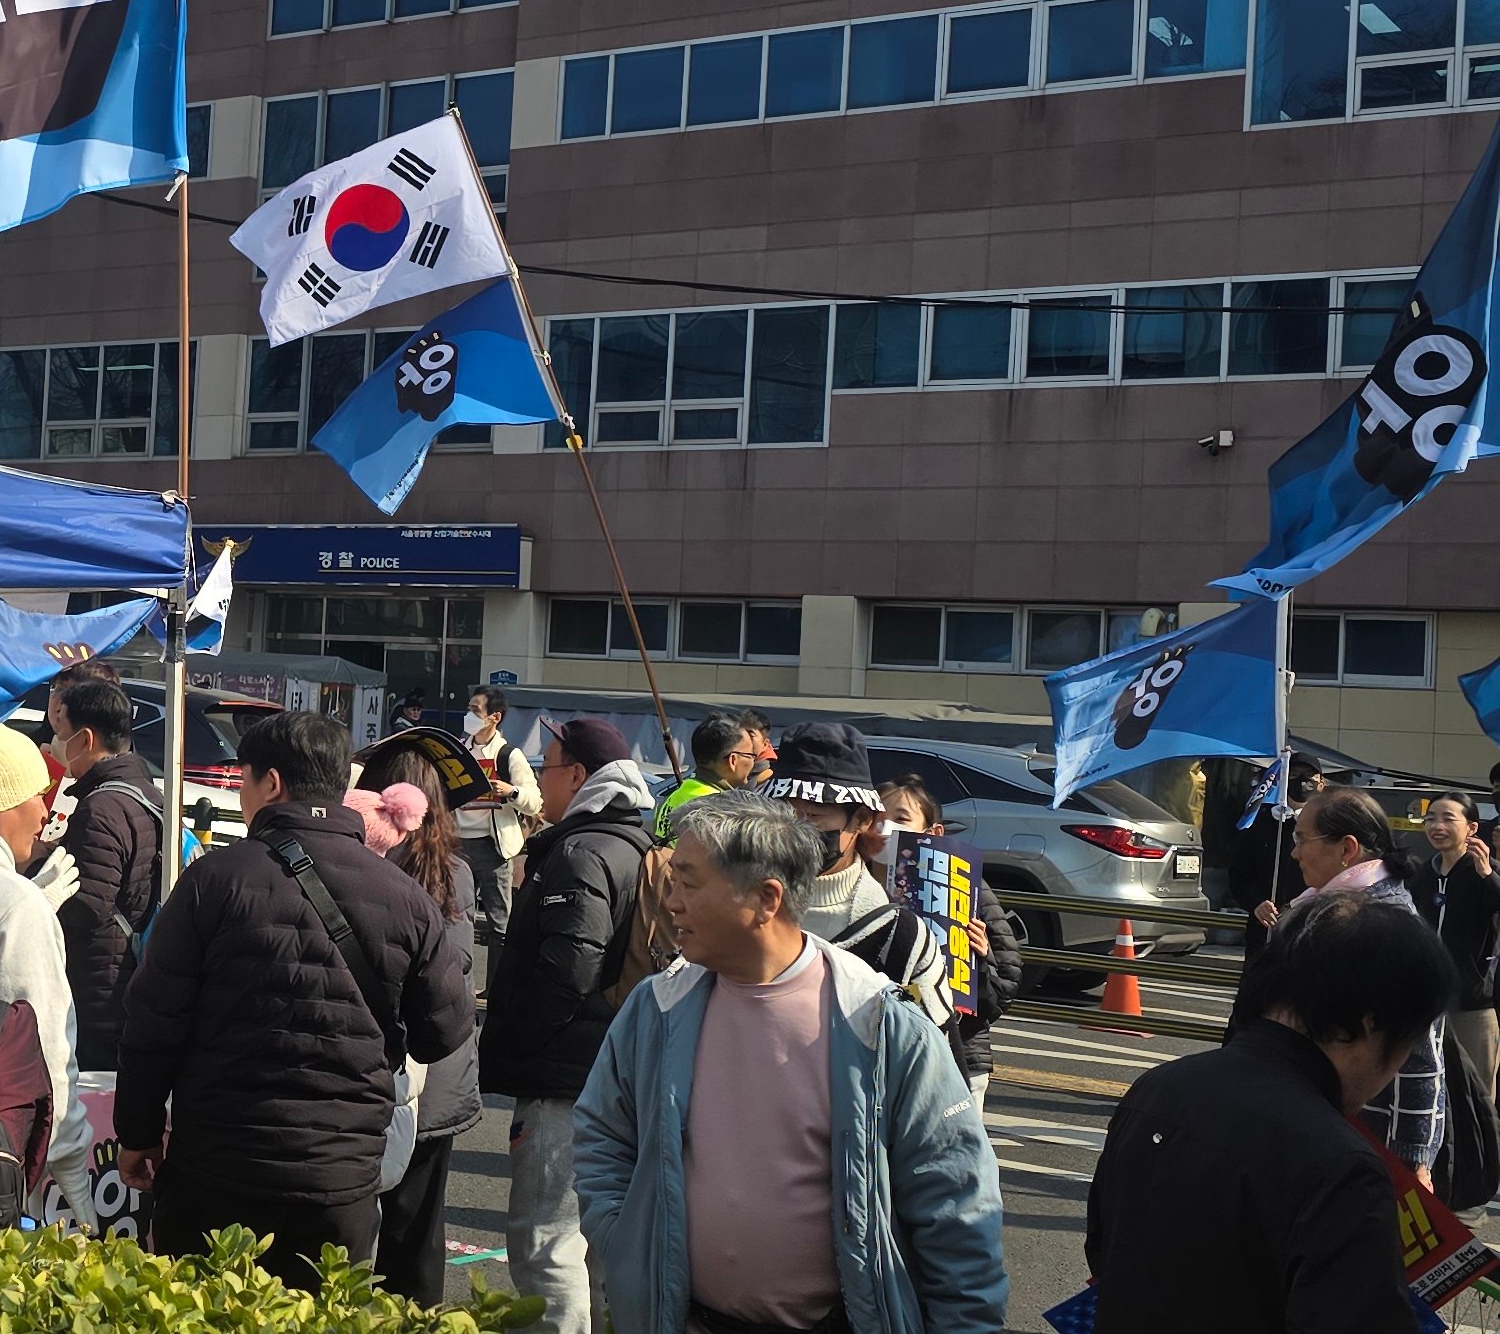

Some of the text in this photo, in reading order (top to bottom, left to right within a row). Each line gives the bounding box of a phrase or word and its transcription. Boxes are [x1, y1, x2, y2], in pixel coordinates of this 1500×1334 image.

[318, 551, 400, 569] 경찰 POLICE
[948, 853, 972, 996] 내란종식
